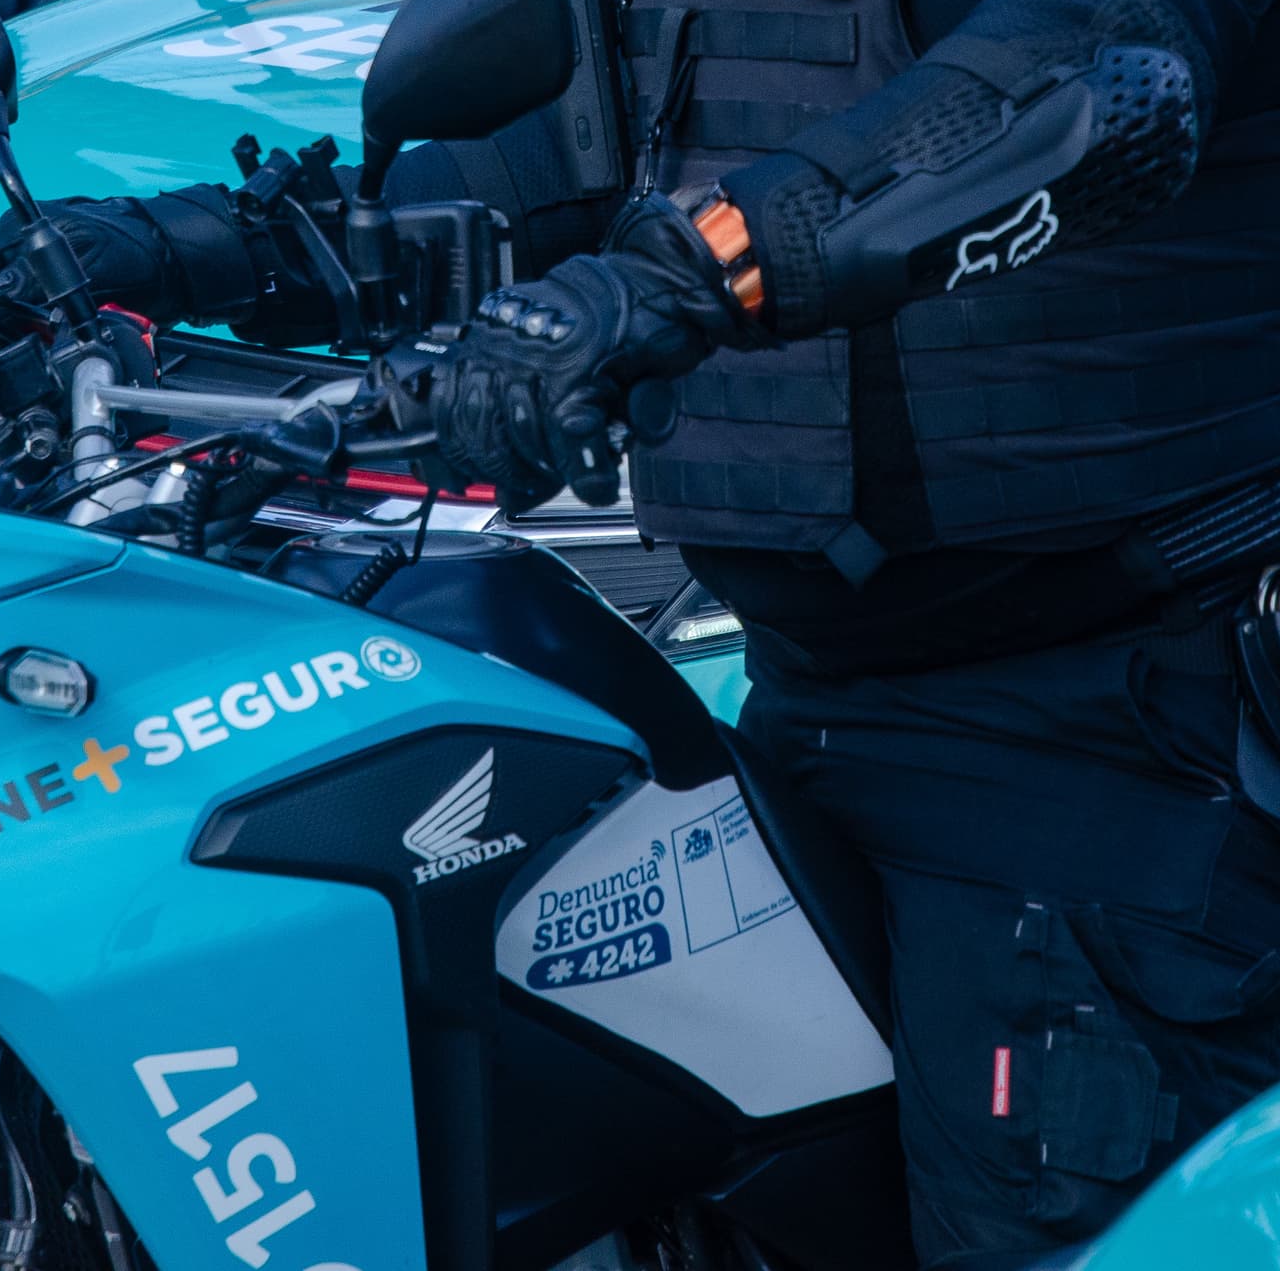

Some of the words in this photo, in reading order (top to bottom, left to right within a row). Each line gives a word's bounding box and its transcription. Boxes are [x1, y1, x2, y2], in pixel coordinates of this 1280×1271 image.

[412, 832, 528, 885] HONDA
[537, 855, 661, 921] Denuncia
[532, 884, 666, 953] SEGURO
[578, 931, 657, 980] 4242
[132, 1045, 317, 1270] 1517
